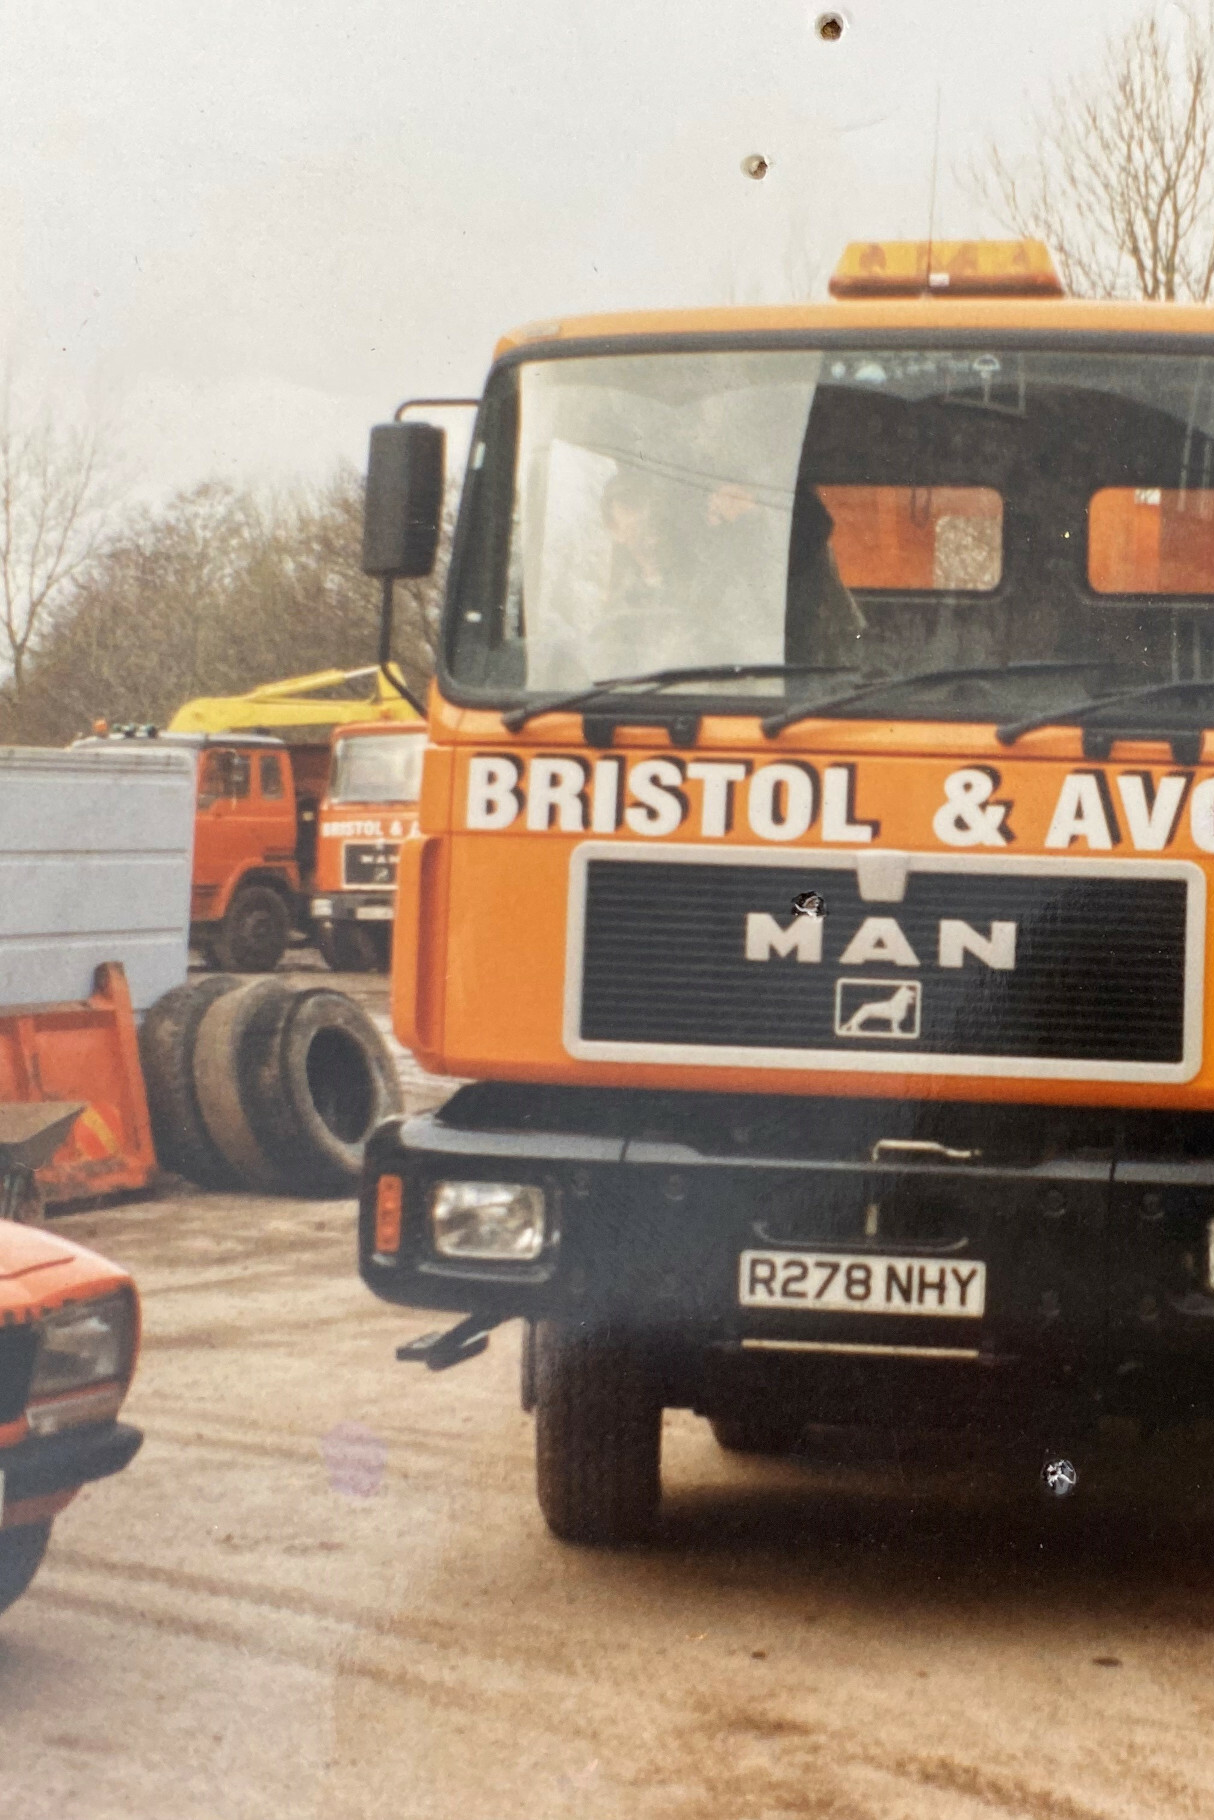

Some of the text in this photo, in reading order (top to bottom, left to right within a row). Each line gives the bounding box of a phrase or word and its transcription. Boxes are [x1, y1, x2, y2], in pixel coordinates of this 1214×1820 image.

[466, 754, 879, 843] BRISTOL
[932, 764, 1014, 848] &
[321, 820, 384, 838] BRISTOL
[745, 912, 1016, 970] MAN
[749, 1258, 978, 1307] R278 NHY
